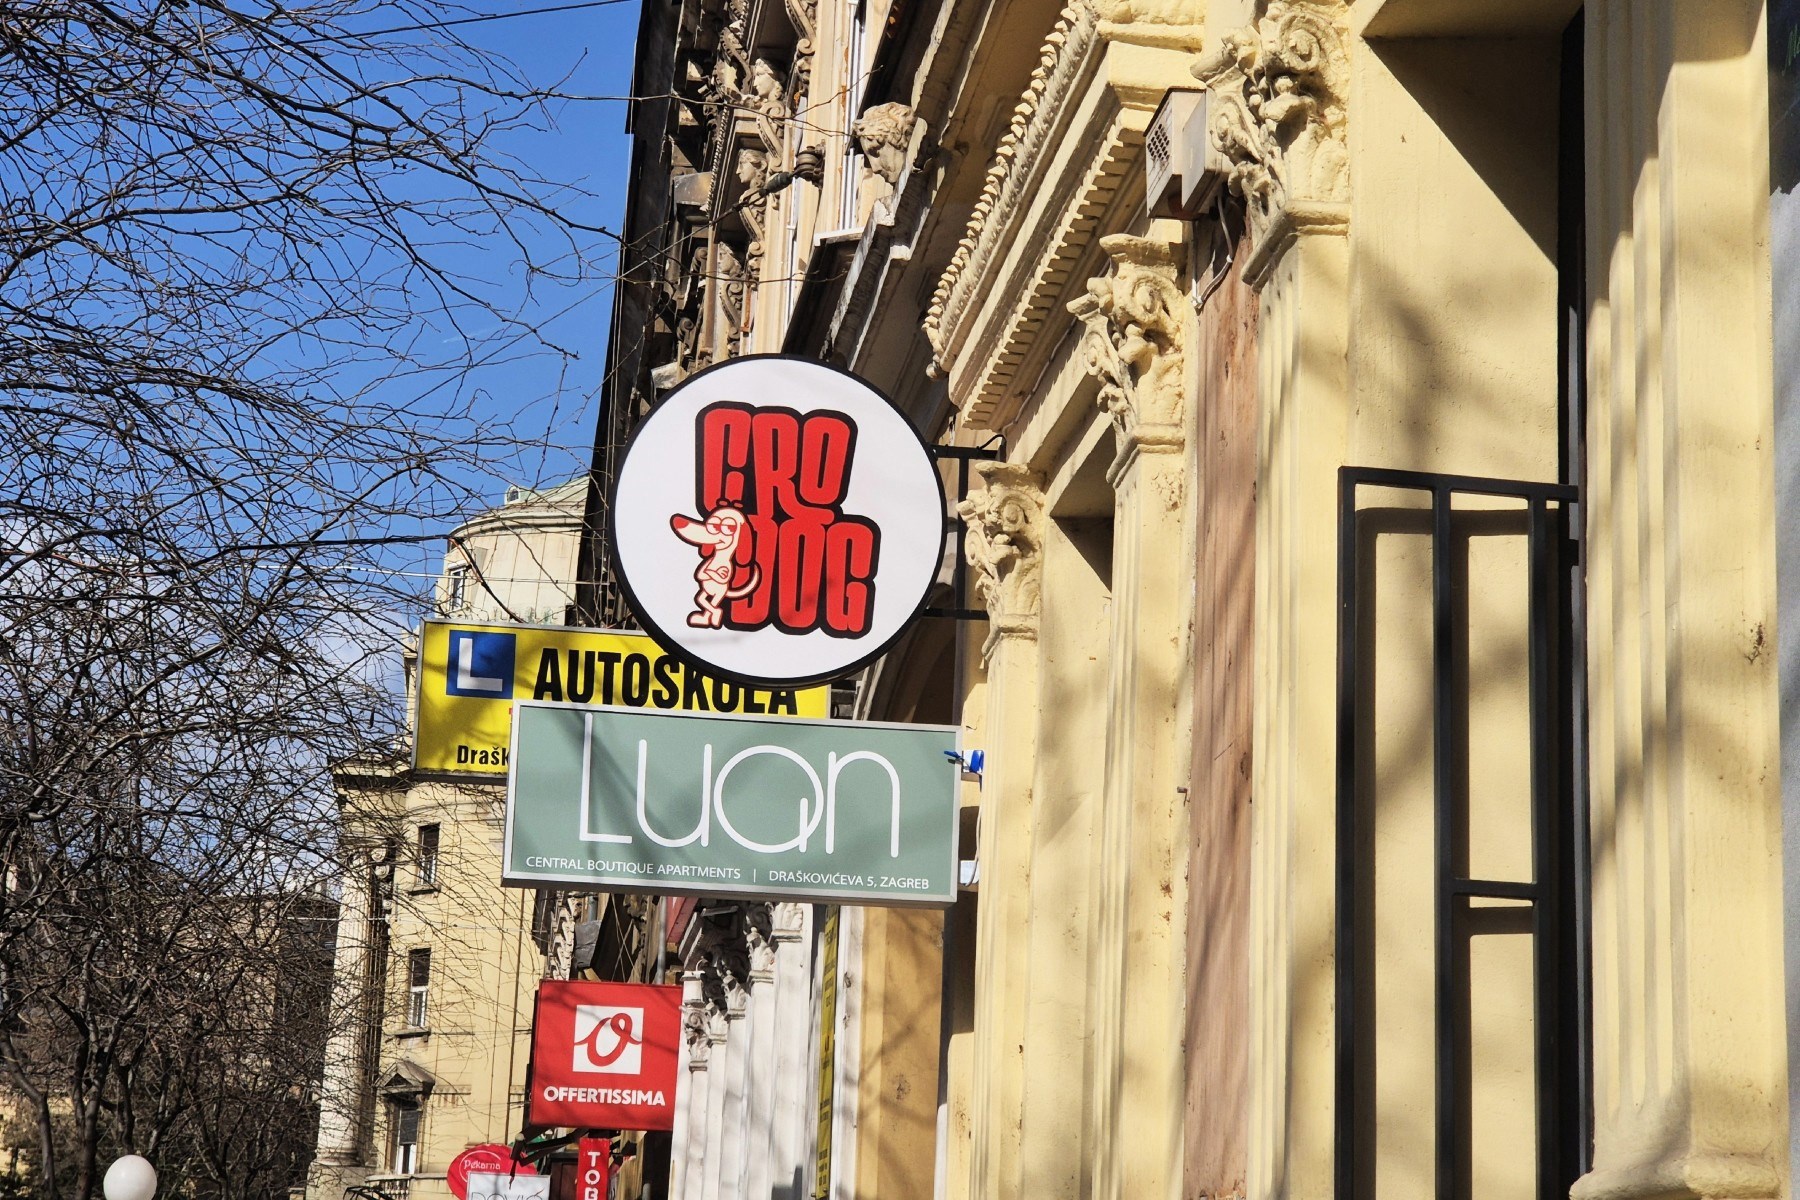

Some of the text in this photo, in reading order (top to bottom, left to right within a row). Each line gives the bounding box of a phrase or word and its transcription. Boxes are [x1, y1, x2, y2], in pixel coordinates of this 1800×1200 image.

[700, 403, 856, 522] CRO
[701, 518, 879, 636] DOG
[525, 856, 930, 890] CENTRAL BOUTIQUE APARTMENTS DRAŠKOVIĆEVA 5, ZAGREB
[543, 1086, 666, 1107] OFFERTISSIMA
